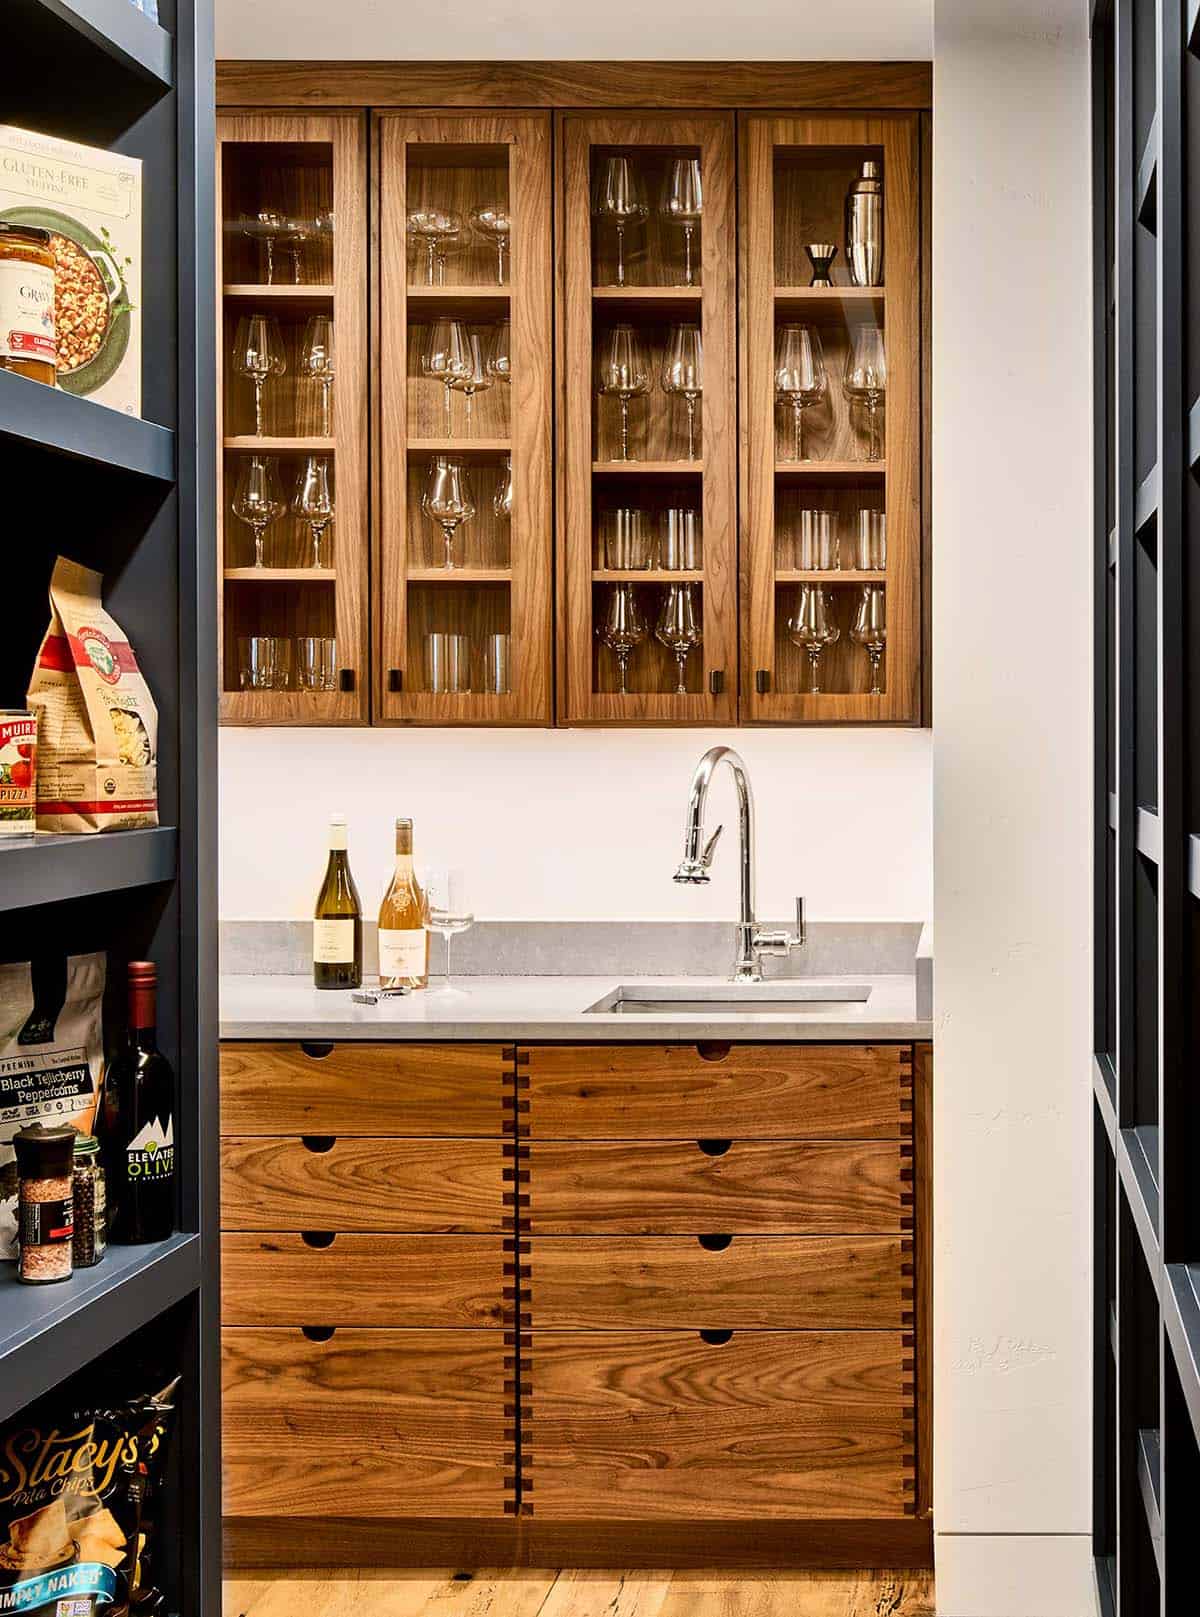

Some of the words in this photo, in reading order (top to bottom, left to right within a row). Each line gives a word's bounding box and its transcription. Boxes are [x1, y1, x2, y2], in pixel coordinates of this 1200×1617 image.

[2, 723, 31, 739] MUIR
[0, 789, 28, 801] PIZZA
[1, 1075, 35, 1091] Black
[34, 1069, 86, 1087] Tellicherry
[17, 1083, 80, 1104] Peppercorns
[0, 1424, 138, 1504] Stacy's
[50, 1475, 95, 1497] Chips
[0, 1583, 44, 1609] IMPLY
[47, 1570, 100, 1592] NAKED
